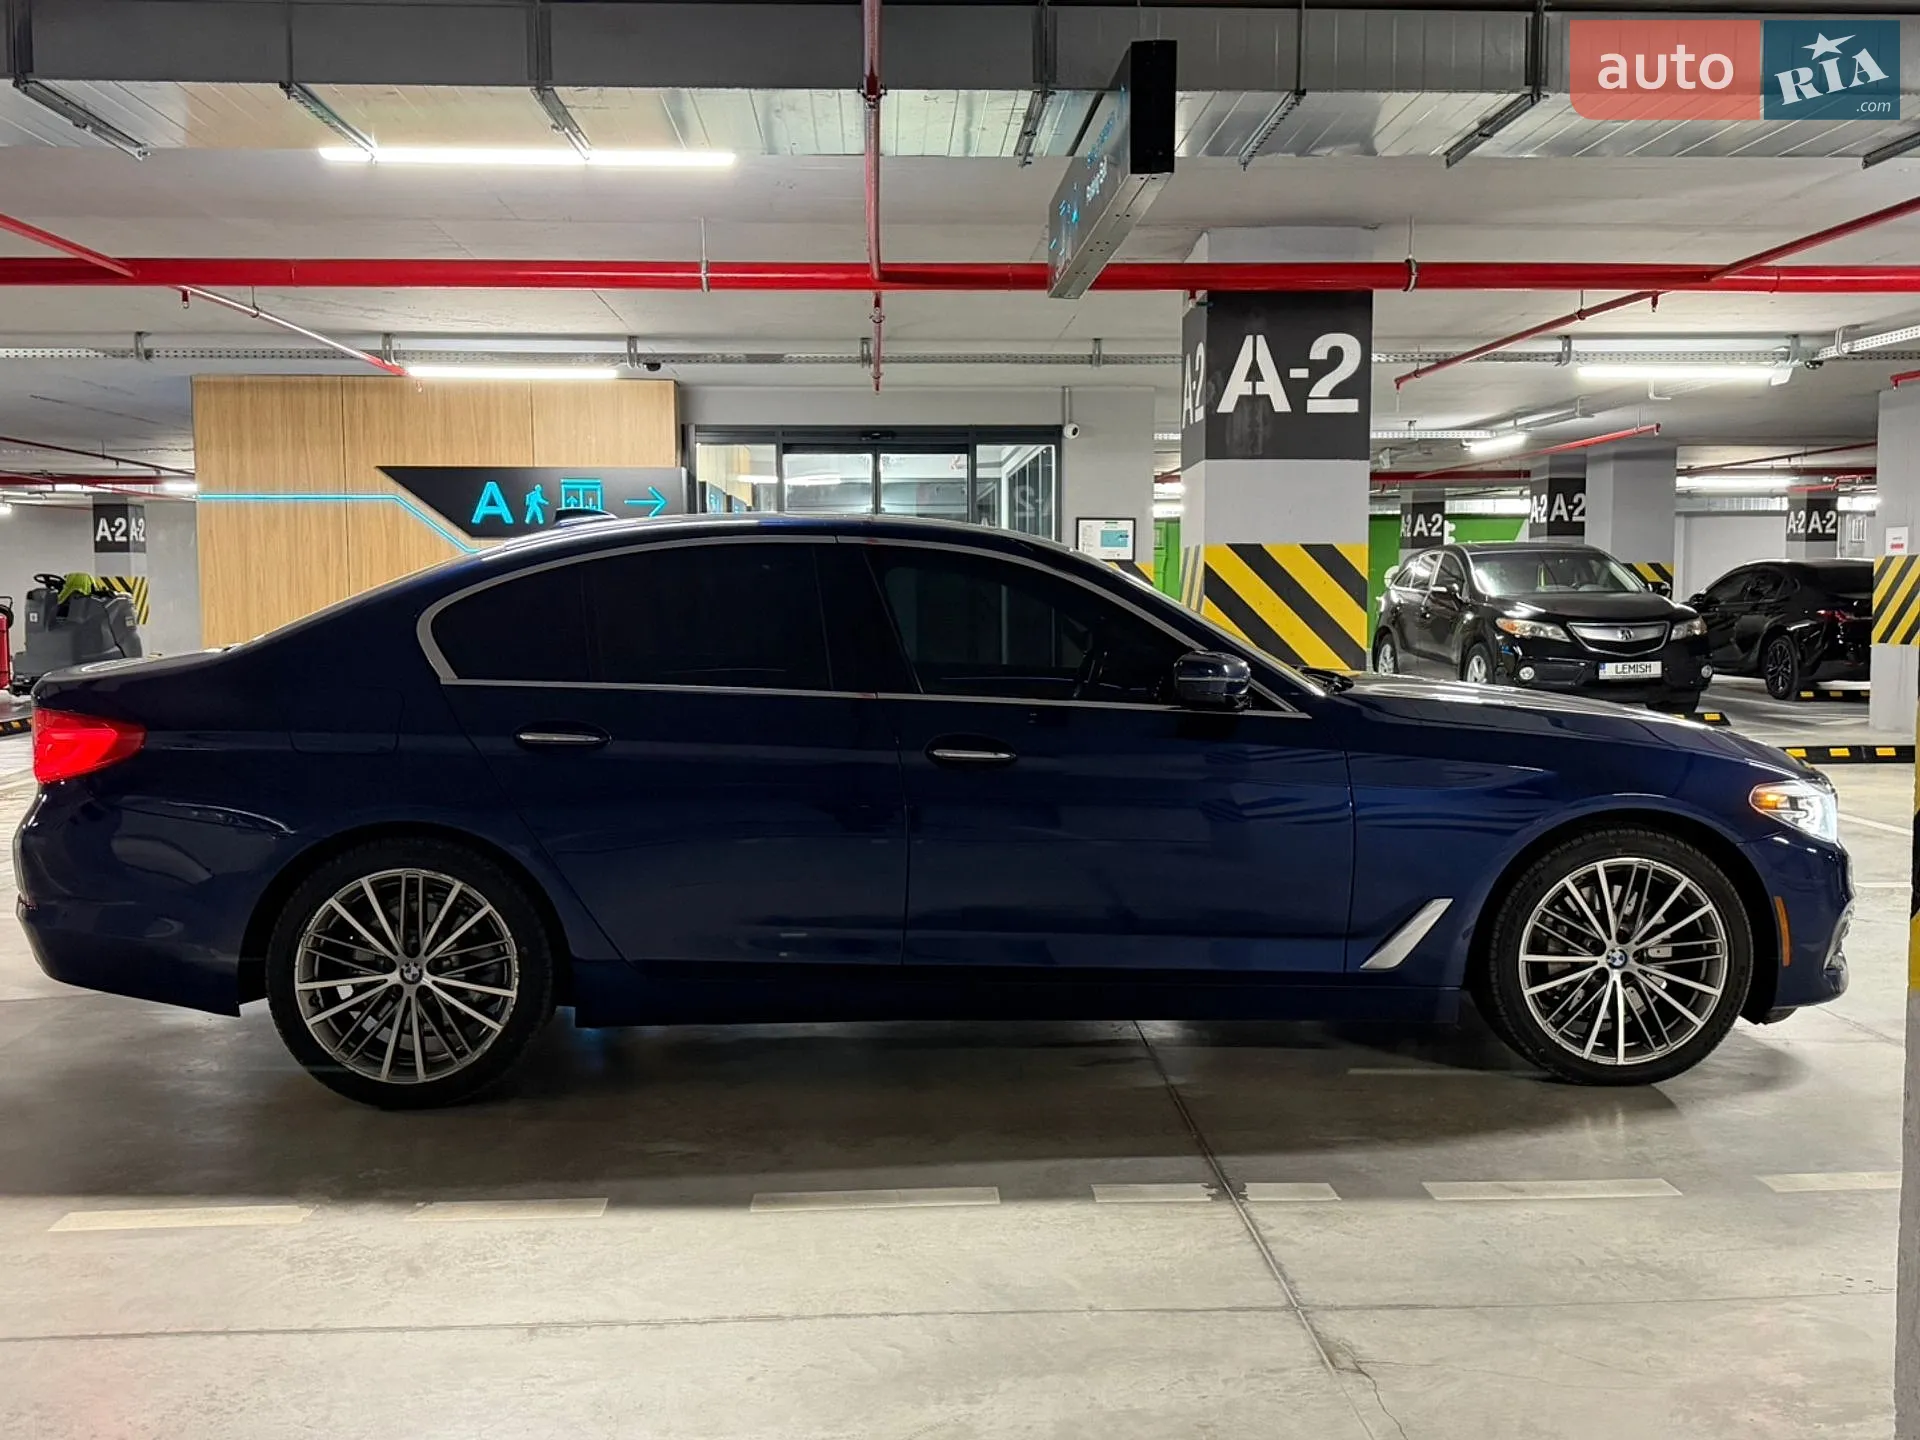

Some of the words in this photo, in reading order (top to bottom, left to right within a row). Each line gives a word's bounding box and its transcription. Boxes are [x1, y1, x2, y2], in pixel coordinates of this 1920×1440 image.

[1182, 341, 1205, 429] A-2
[1216, 332, 1362, 413] A-2
[471, 480, 515, 525] A
[1530, 494, 1547, 523] A-2
[1549, 493, 1586, 521] A-2
[95, 517, 127, 542] A-2
[1413, 513, 1443, 537] A-2
[1787, 510, 1805, 534] A-2
[1807, 510, 1836, 533] A-2
[1615, 664, 1651, 674] LEMISH
